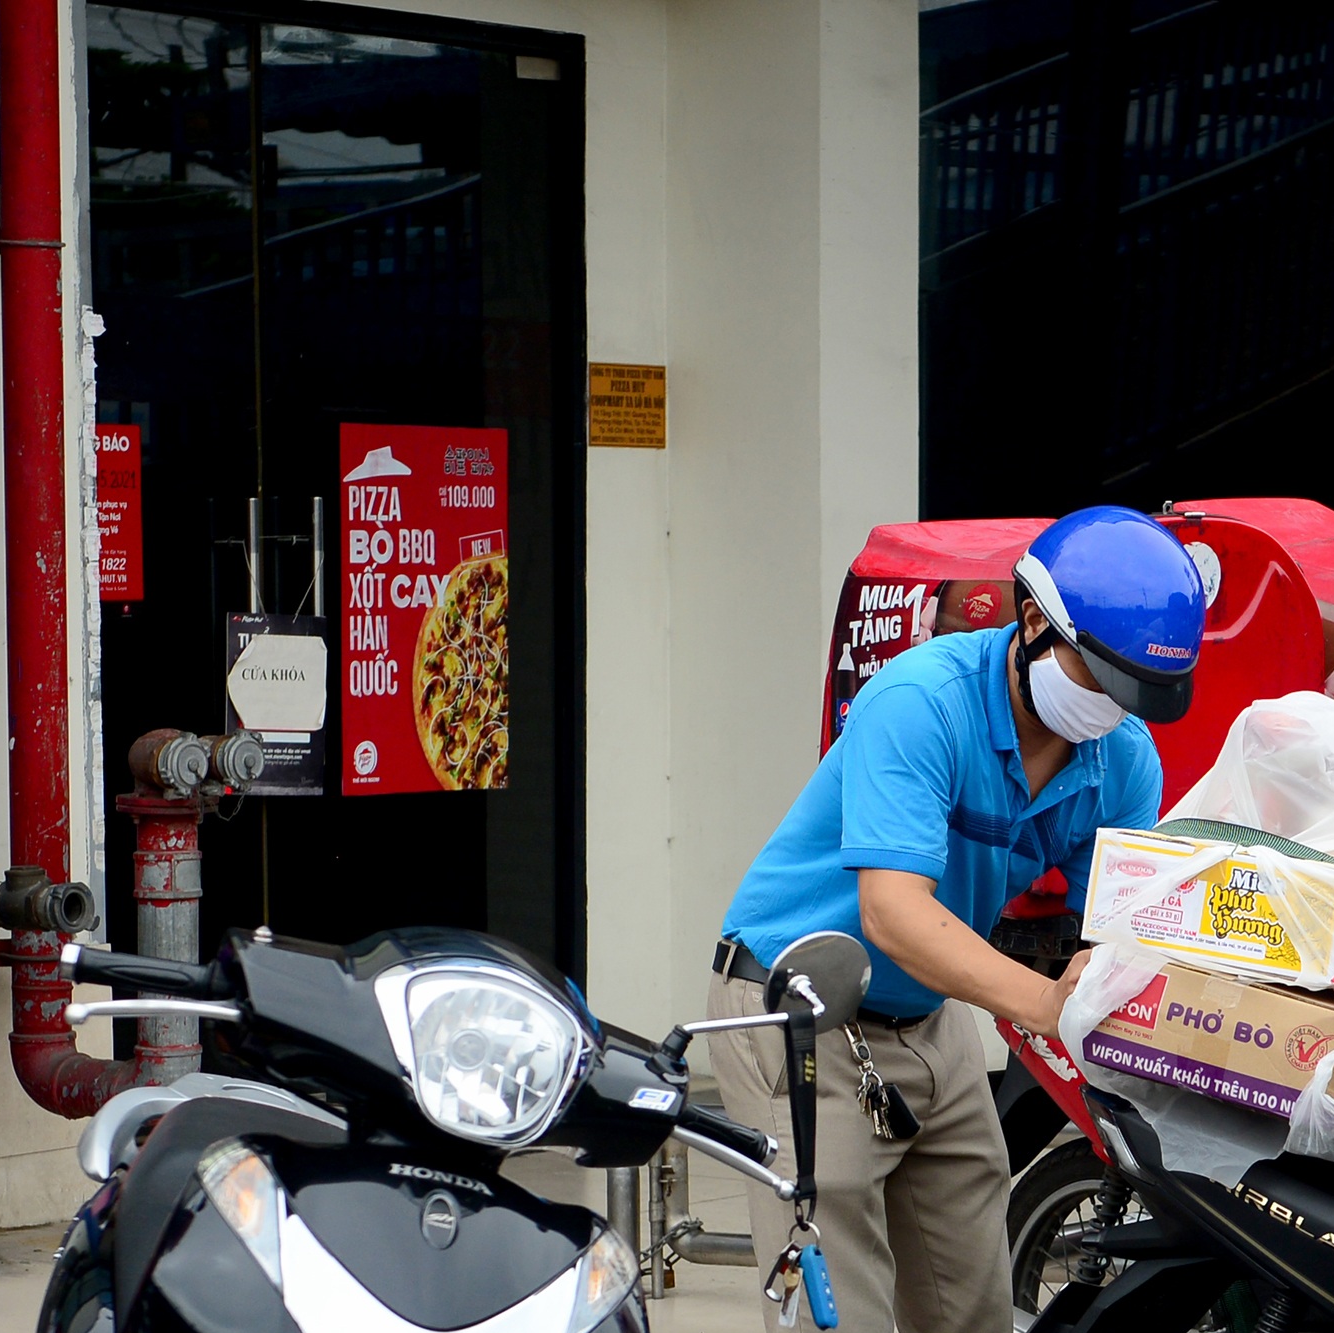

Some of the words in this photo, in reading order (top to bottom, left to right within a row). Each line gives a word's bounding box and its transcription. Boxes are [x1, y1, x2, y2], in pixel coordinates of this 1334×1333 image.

[103, 432, 130, 452] BÁO
[348, 485, 402, 522] PIZZA
[447, 485, 495, 508] 109.000
[349, 520, 394, 564] BÒ
[398, 528, 435, 566] BBQ
[471, 537, 491, 557] NEW
[101, 558, 127, 571] 1822
[349, 561, 386, 608] XỐT
[390, 573, 452, 609] CAY
[858, 585, 904, 612] MUA
[903, 584, 927, 637] 1
[349, 609, 389, 651] HÀN
[849, 612, 902, 652] TẶNG
[1146, 643, 1191, 659] HONDA
[242, 665, 267, 681] CỬA
[271, 665, 306, 681] KHÓA
[349, 650, 398, 697] QUỐC
[1210, 884, 1255, 916] Phú
[1184, 928, 1198, 937] NAM
[1213, 904, 1284, 946] Hương
[1166, 1002, 1225, 1034] PHỞ
[1233, 1021, 1274, 1049] BÒ
[1092, 1043, 1132, 1067] VIFON
[1134, 1056, 1171, 1077] XUẤT
[1172, 1067, 1211, 1089] KHẨU
[1213, 1080, 1249, 1101] TRÊN
[1252, 1090, 1278, 1109] 100
[388, 1163, 494, 1197] HONDA
